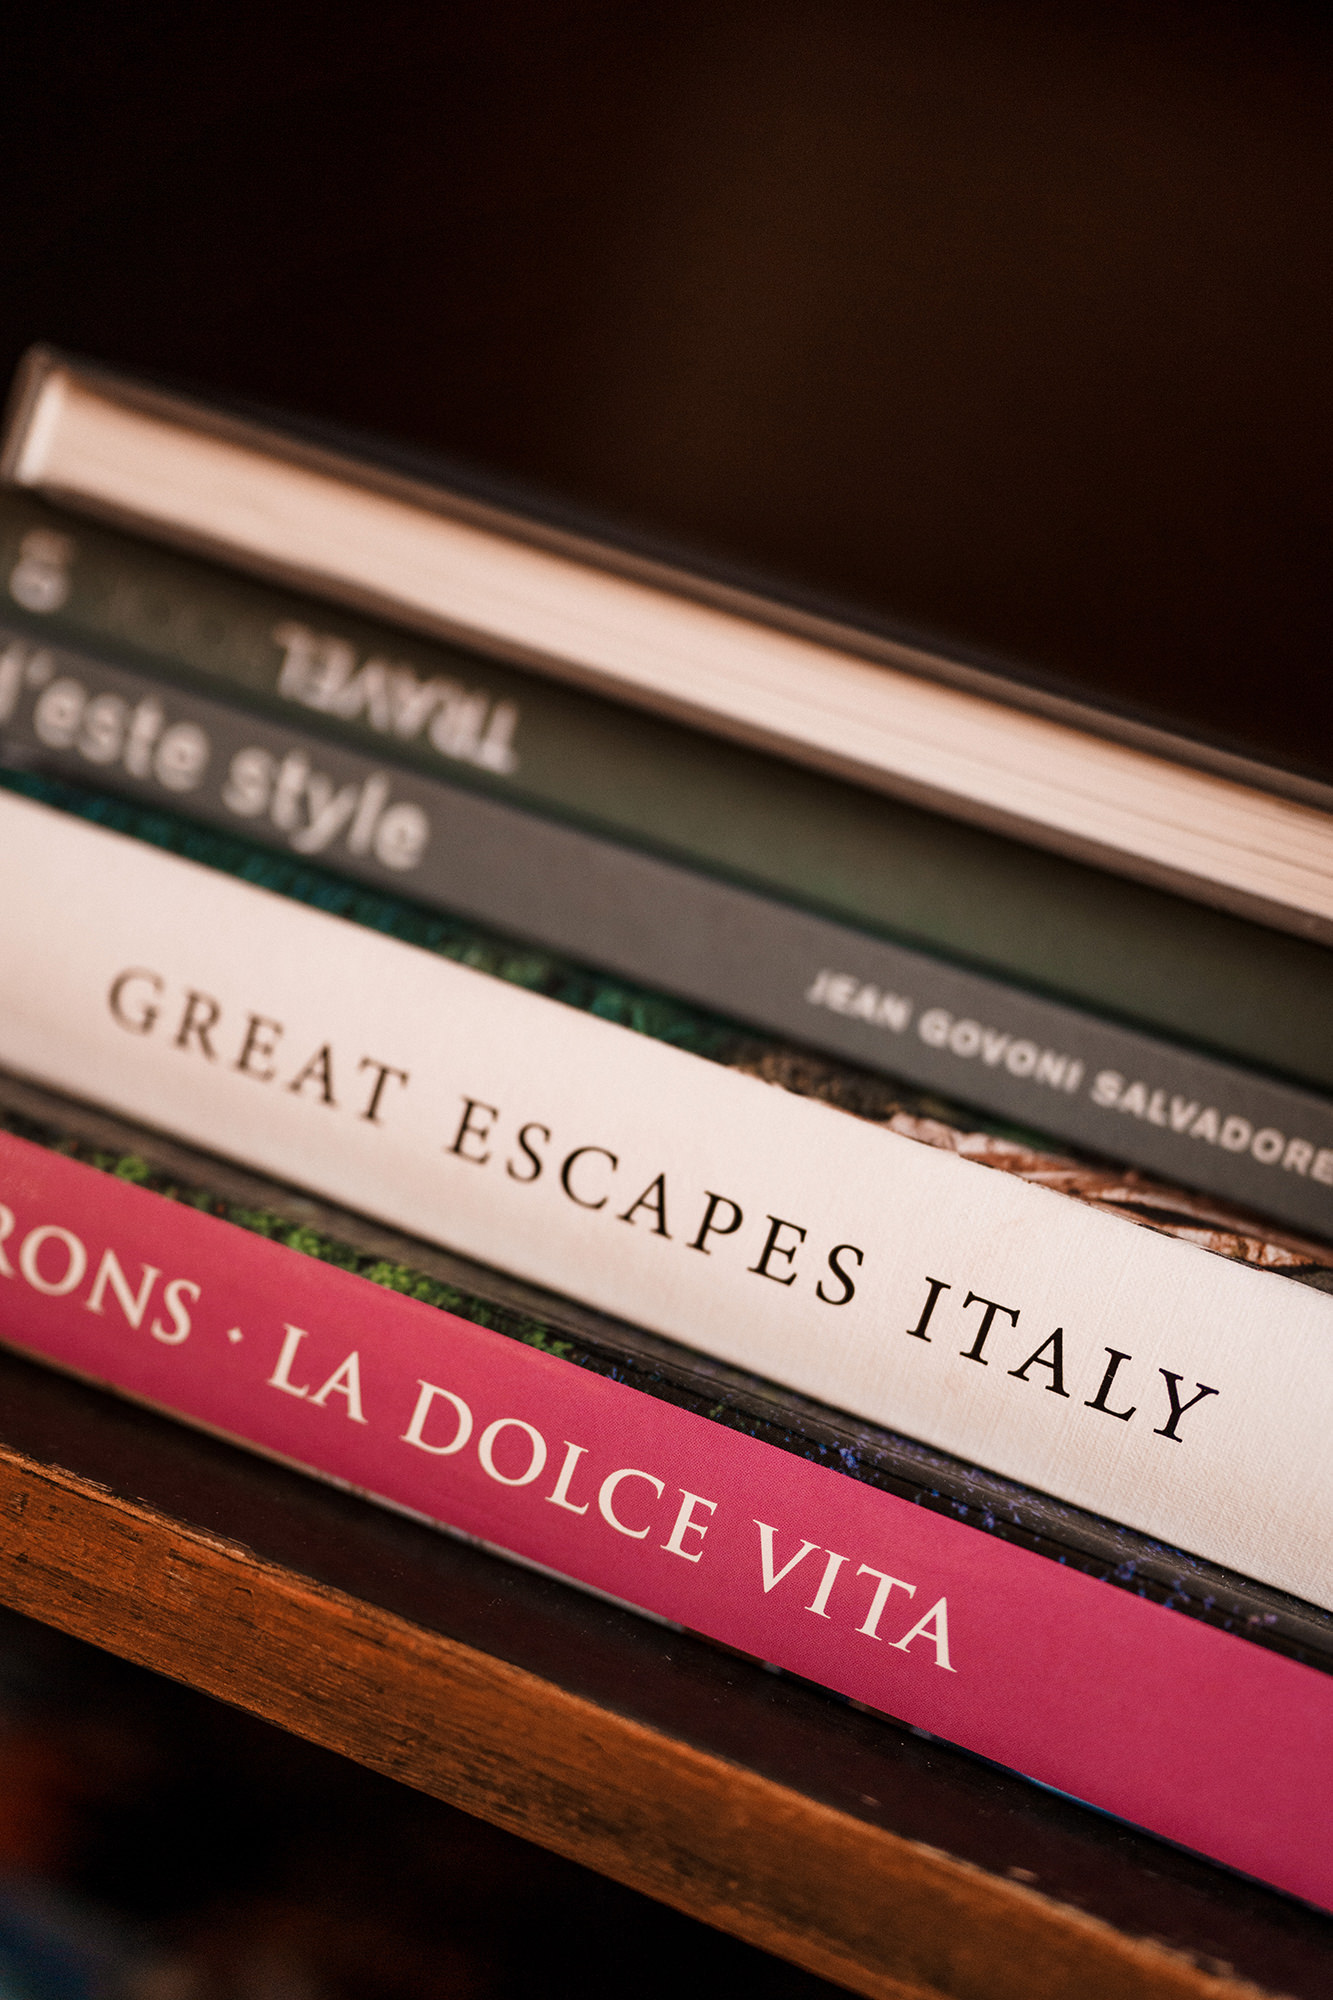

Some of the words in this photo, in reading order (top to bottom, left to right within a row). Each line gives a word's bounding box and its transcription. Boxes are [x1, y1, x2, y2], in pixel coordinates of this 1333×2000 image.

[220, 746, 432, 872] style
[107, 966, 411, 1127] GREAT
[446, 1094, 865, 1306] ESCAPES
[906, 1275, 1220, 1443] ITALY
[806, 968, 914, 1034] JEAN
[917, 1006, 1085, 1096] GOVONI
[1091, 1068, 1333, 1187] SALVADORE
[266, 1322, 370, 1426] LA
[400, 1378, 719, 1564] DOLCE
[752, 1518, 959, 1674] VITA
